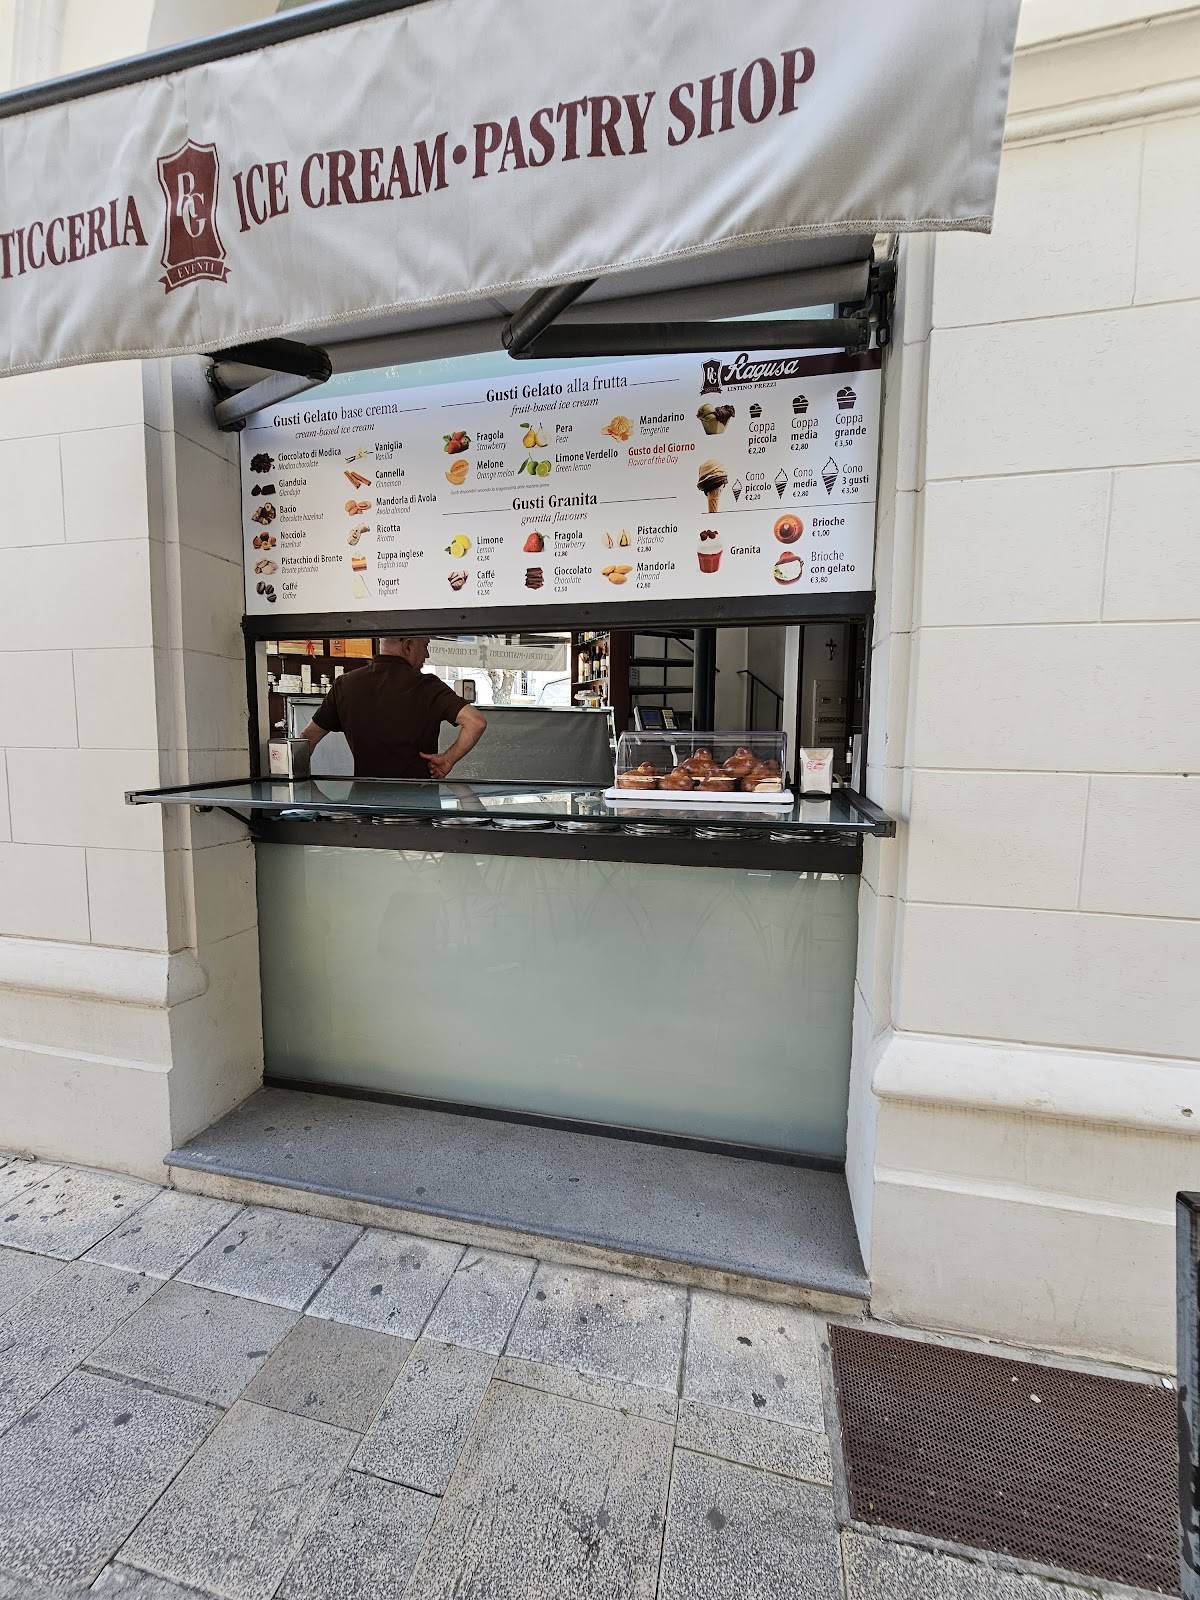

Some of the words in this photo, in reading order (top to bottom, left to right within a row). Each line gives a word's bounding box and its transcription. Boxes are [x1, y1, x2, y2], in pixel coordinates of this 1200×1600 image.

[232, 160, 290, 233] ICE
[300, 131, 449, 208] CREAM
[470, 91, 657, 179] PASTRY
[667, 47, 817, 147] SHOP
[175, 260, 217, 280] EVENTI
[725, 352, 799, 381] Ragusa
[486, 386, 518, 403] Gusti
[522, 383, 563, 398] Gelato
[567, 378, 589, 393] alla
[592, 375, 628, 391] frutta
[727, 383, 753, 391] LISTINO
[509, 400, 557, 417] fruit-based
[559, 400, 570, 410] ice
[571, 397, 599, 408] cream
[273, 412, 300, 427] Gusti
[303, 408, 338, 424] Gelato
[341, 406, 364, 419] base
[365, 403, 398, 416] crema
[639, 412, 685, 425] Mandarino
[835, 413, 863, 425] Coppa
[555, 424, 573, 433] Pera
[749, 421, 776, 433] Coppa
[791, 417, 819, 429] Coppa
[295, 426, 339, 439] cream-based
[341, 425, 351, 434] ice
[352, 423, 375, 432] cream
[476, 430, 504, 442] Fragola
[639, 425, 670, 436] Tangerine
[791, 430, 818, 441] media
[835, 426, 867, 438] grande
[555, 434, 569, 443] Pear
[748, 433, 777, 446] piccola
[375, 441, 403, 452] Vaniglia
[476, 441, 507, 451] Strawberry
[628, 446, 653, 456] Gusto
[654, 444, 666, 454] del
[667, 442, 696, 452] Giorno
[278, 450, 309, 462] Cioccolato
[310, 449, 317, 458] di
[318, 447, 342, 458] Modica
[555, 451, 584, 463] Limone
[585, 448, 619, 459] Verdello
[476, 460, 504, 469] Melone
[627, 457, 645, 467] Flavor
[665, 455, 679, 464] Day
[555, 463, 571, 473] Green
[572, 462, 592, 471] lemon
[793, 468, 813, 477] Cono
[842, 464, 863, 474] Cono
[375, 468, 405, 479] Cannella
[745, 472, 765, 481] Cono
[278, 478, 307, 488] Gianduia
[793, 478, 817, 488] media
[842, 477, 847, 485] 3
[849, 475, 869, 486] gusti
[745, 482, 772, 494] piccolo
[376, 497, 408, 506] Mandorla
[409, 496, 416, 504] di
[417, 494, 437, 503] Avola
[512, 496, 545, 511] Gusti
[548, 493, 598, 508] Granita
[279, 505, 297, 514] Bacio
[520, 512, 552, 525] granita
[553, 511, 588, 522] flavours
[812, 517, 845, 527] Brioche
[376, 524, 401, 533] Ricotta
[637, 525, 678, 535] Pistacchio
[280, 531, 306, 540] Nocciola
[477, 536, 504, 545] Limone
[554, 531, 583, 541] Fragola
[637, 535, 665, 545] Pistachio
[476, 546, 495, 554] Lemon
[554, 540, 586, 550] Strawberry
[730, 545, 761, 556] Granita
[281, 556, 313, 565] Pistacchio
[314, 555, 320, 563] di
[321, 554, 343, 563] Bronte
[377, 552, 398, 561] Zuppa
[400, 549, 424, 559] inglese
[811, 551, 845, 562] Brioche
[554, 566, 592, 576] Cioccolato
[637, 562, 675, 572] Mandorla
[810, 565, 826, 573] con
[827, 564, 855, 575] gelato
[554, 575, 582, 585] Chocolate
[637, 572, 660, 581] Almond
[377, 578, 400, 588] Yogurt
[476, 580, 494, 588] Coffee
